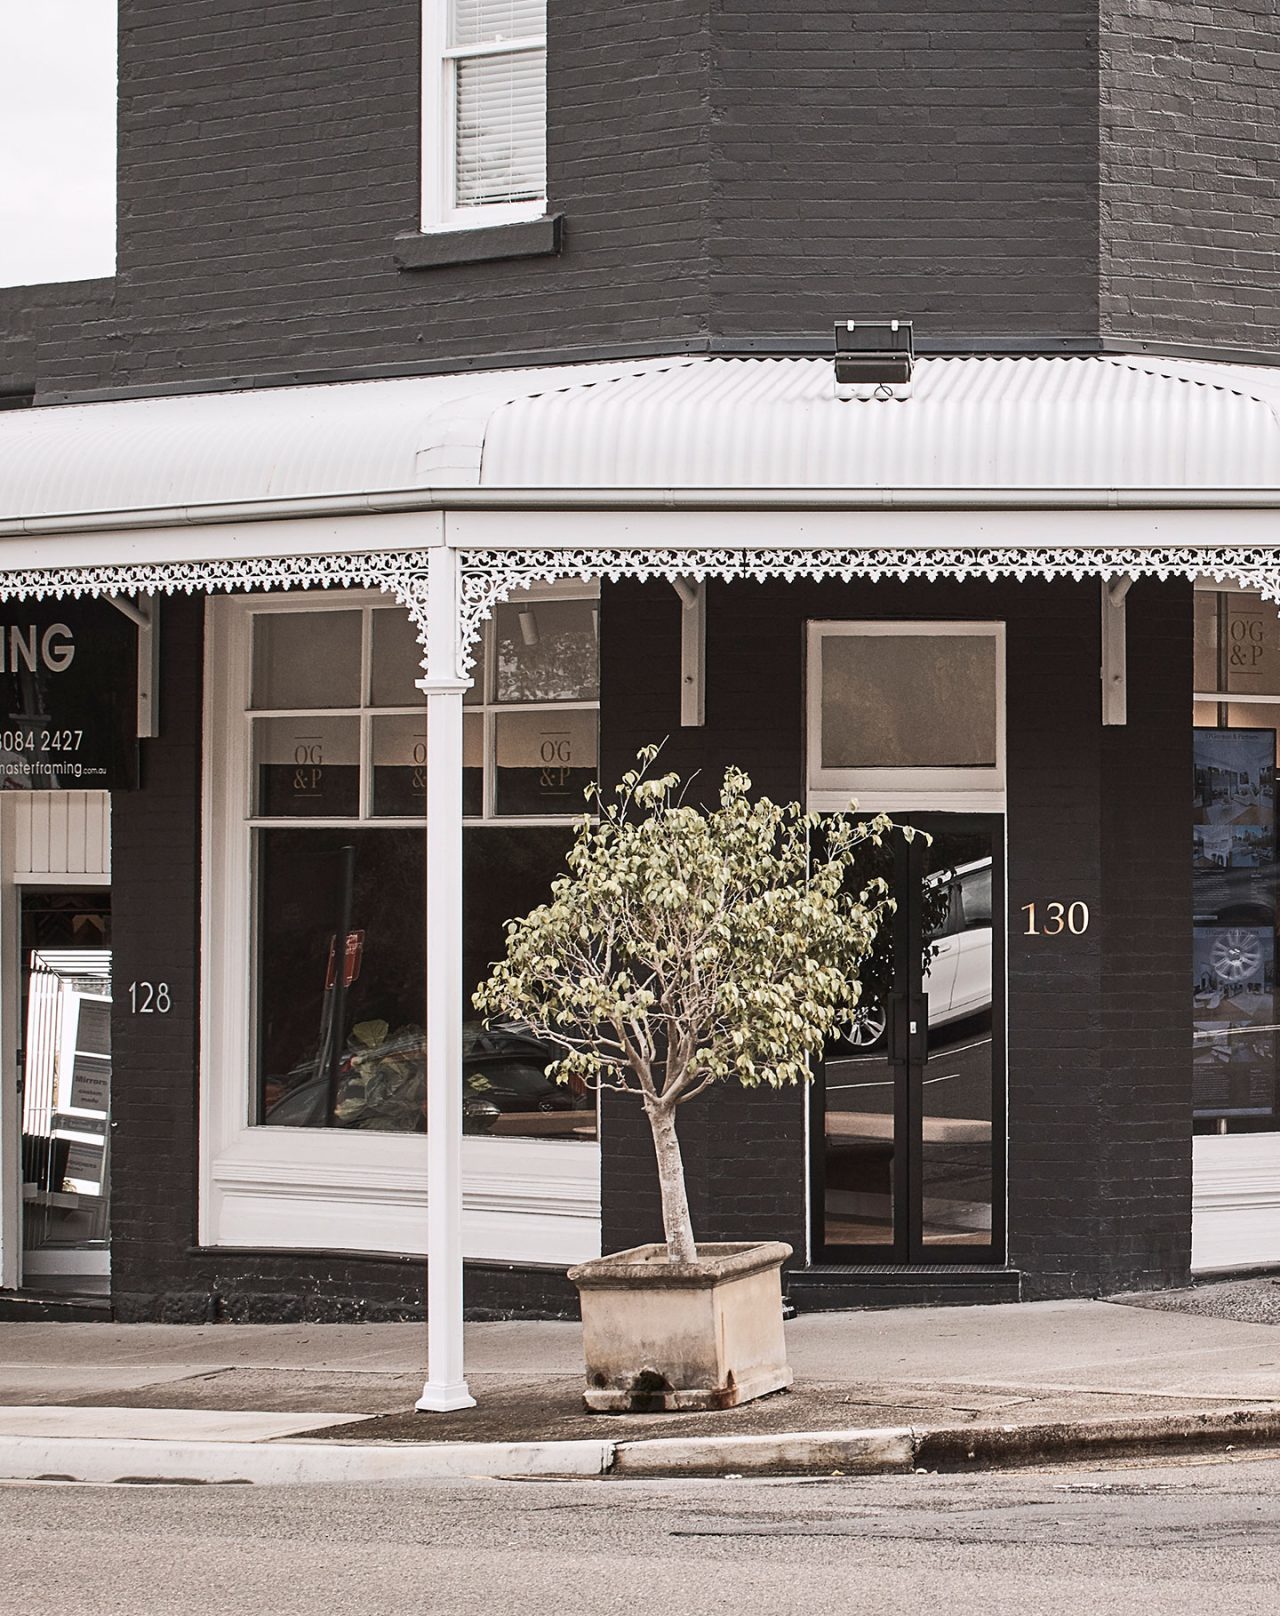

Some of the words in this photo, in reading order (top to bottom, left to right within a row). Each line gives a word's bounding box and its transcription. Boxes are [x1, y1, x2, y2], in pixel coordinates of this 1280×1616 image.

[1230, 619, 1264, 642] O'G
[1230, 645, 1248, 666] &
[1251, 645, 1264, 666] P
[40, 730, 83, 751] 2427
[294, 744, 323, 765] O'G
[540, 740, 571, 763] O'G
[311, 769, 322, 789] P
[558, 766, 571, 787] P
[1020, 901, 1089, 935] 130
[128, 981, 171, 1014] 128
[75, 1075, 108, 1086] Mirrors
